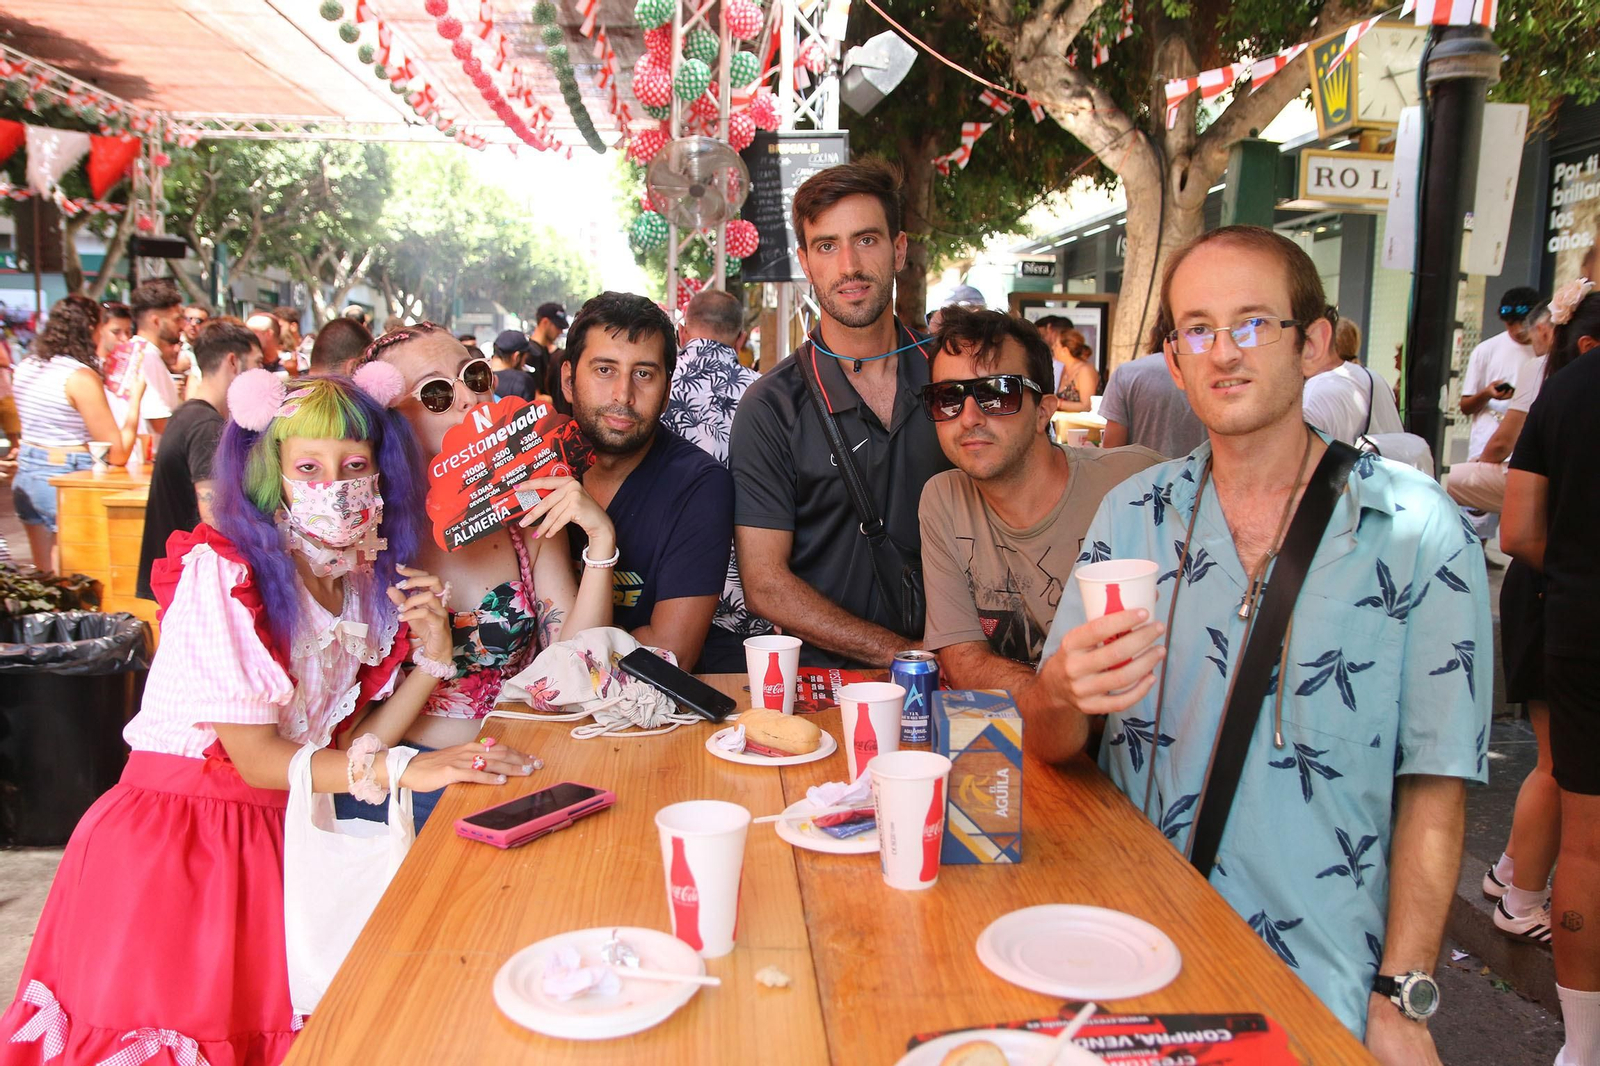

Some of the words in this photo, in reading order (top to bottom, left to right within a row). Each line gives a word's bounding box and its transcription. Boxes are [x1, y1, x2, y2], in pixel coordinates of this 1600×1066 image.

[1314, 166, 1389, 190] ROL
[1553, 161, 1584, 184] Por
[1549, 209, 1574, 231] los
[1547, 230, 1595, 253] años.
[433, 403, 548, 478] crestanevada
[520, 431, 538, 446] +300
[521, 437, 543, 453] FURGOS
[492, 447, 511, 462] +500
[494, 454, 515, 469] MOTOS
[461, 461, 486, 479] +1000
[465, 469, 489, 485] COCHES
[506, 463, 527, 481] MESES
[507, 471, 528, 487] PRUEBA
[469, 491, 477, 500] 15
[454, 505, 511, 547] ALMERÍA
[1134, 1028, 1233, 1047] COMPRA,
